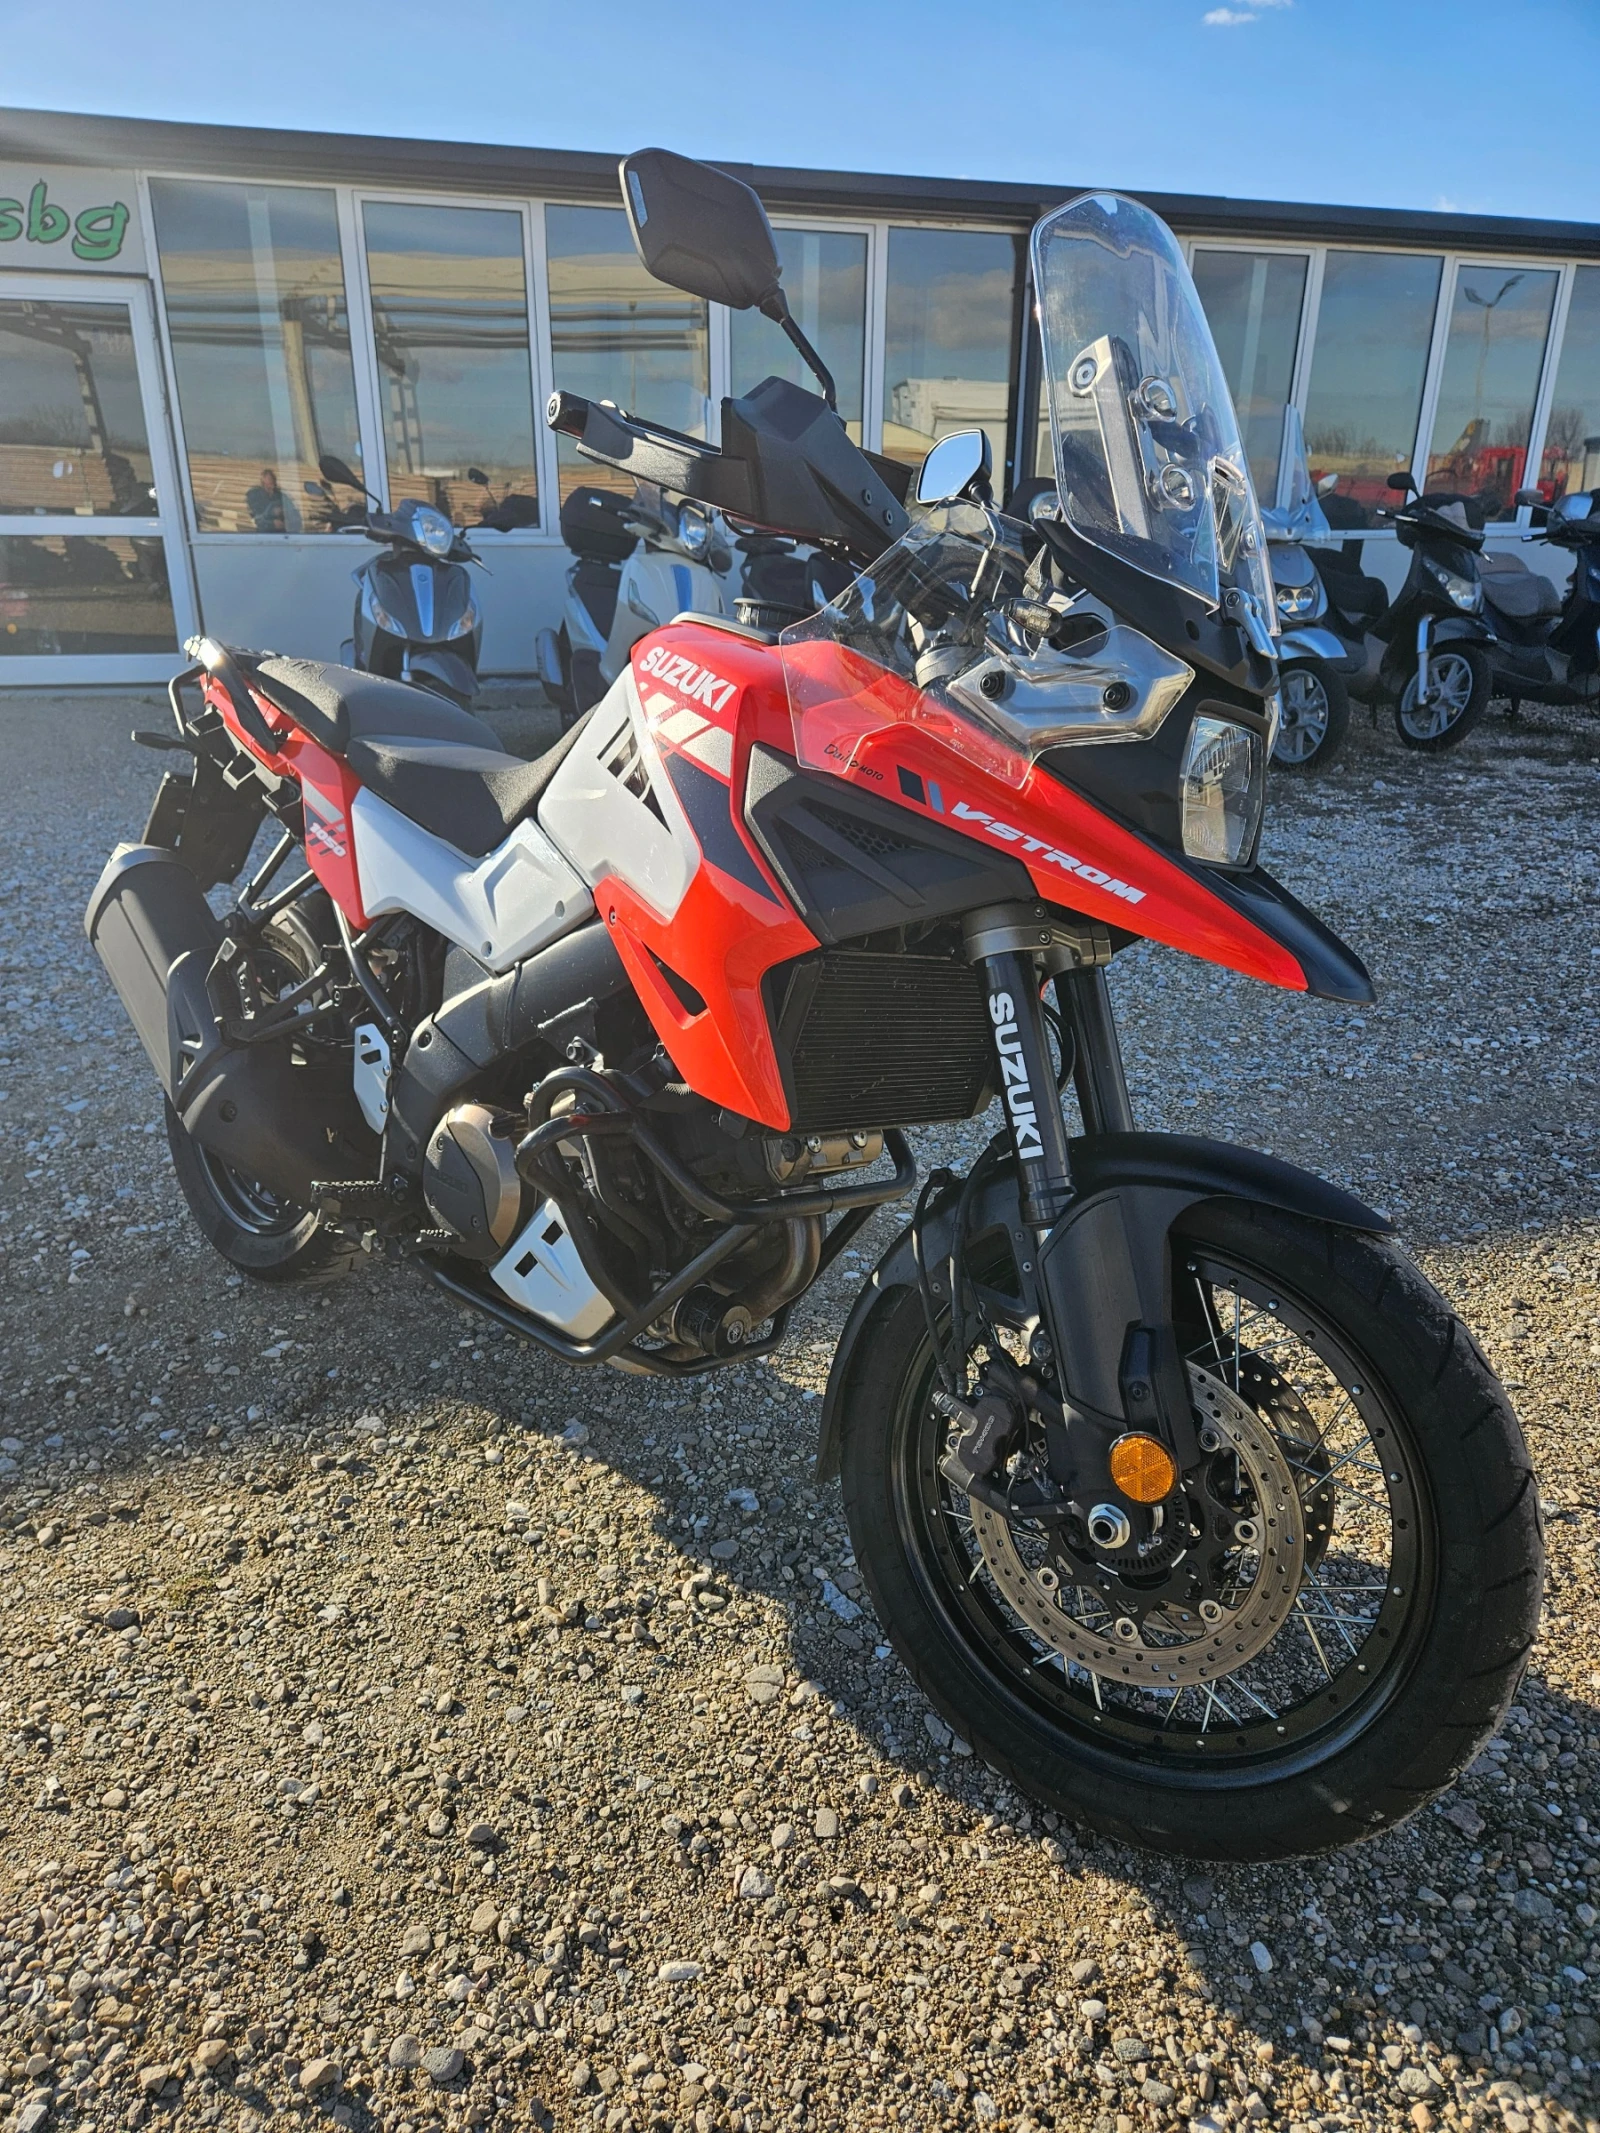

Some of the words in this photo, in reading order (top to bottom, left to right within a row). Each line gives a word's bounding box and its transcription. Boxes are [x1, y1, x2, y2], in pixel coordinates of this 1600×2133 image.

[639, 646, 738, 713] SUZUKI
[858, 764, 884, 781] MOTO
[310, 822, 346, 857] 1050
[951, 801, 1147, 905] V-STROM
[989, 992, 1044, 1160] SUZUKI
